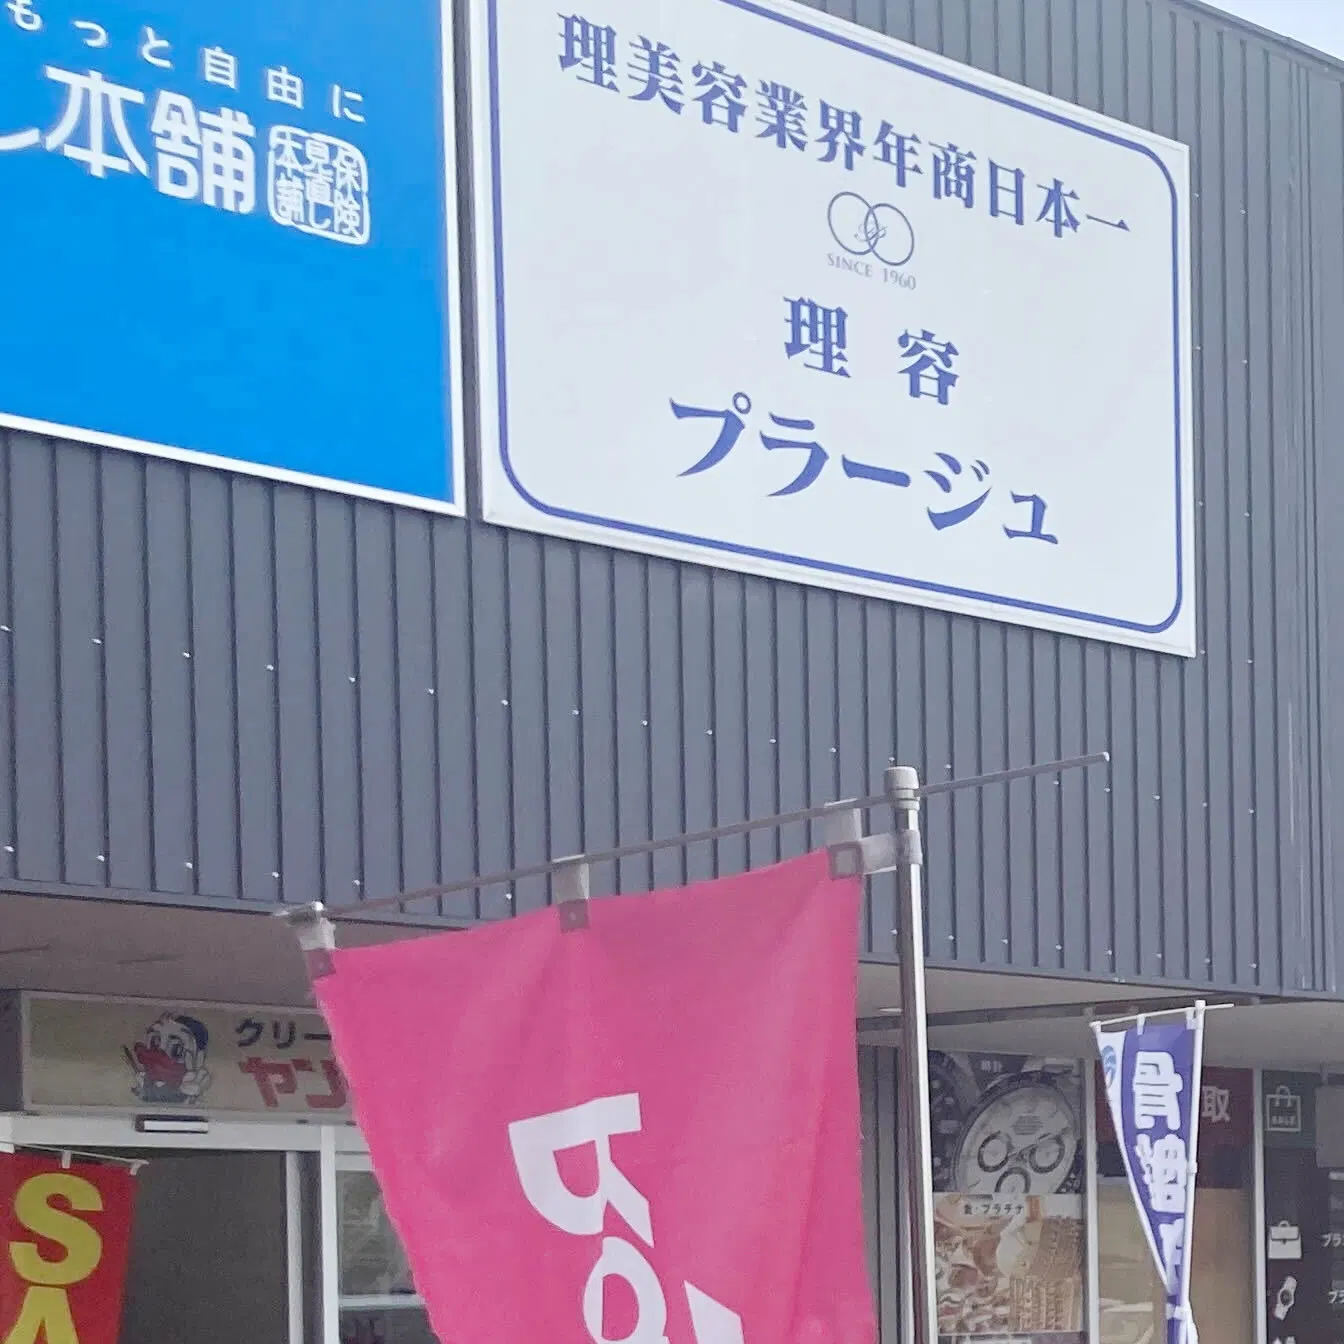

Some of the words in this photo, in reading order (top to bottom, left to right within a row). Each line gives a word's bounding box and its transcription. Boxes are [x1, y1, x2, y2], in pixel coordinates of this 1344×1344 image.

[7, 0, 366, 123] もっと自由に
[556, 12, 1131, 239] 理美容業界年商日本一
[826, 252, 874, 279] SINCE
[883, 267, 917, 290] 1960
[784, 296, 960, 406] 理容
[669, 391, 1059, 546] プラージュ
